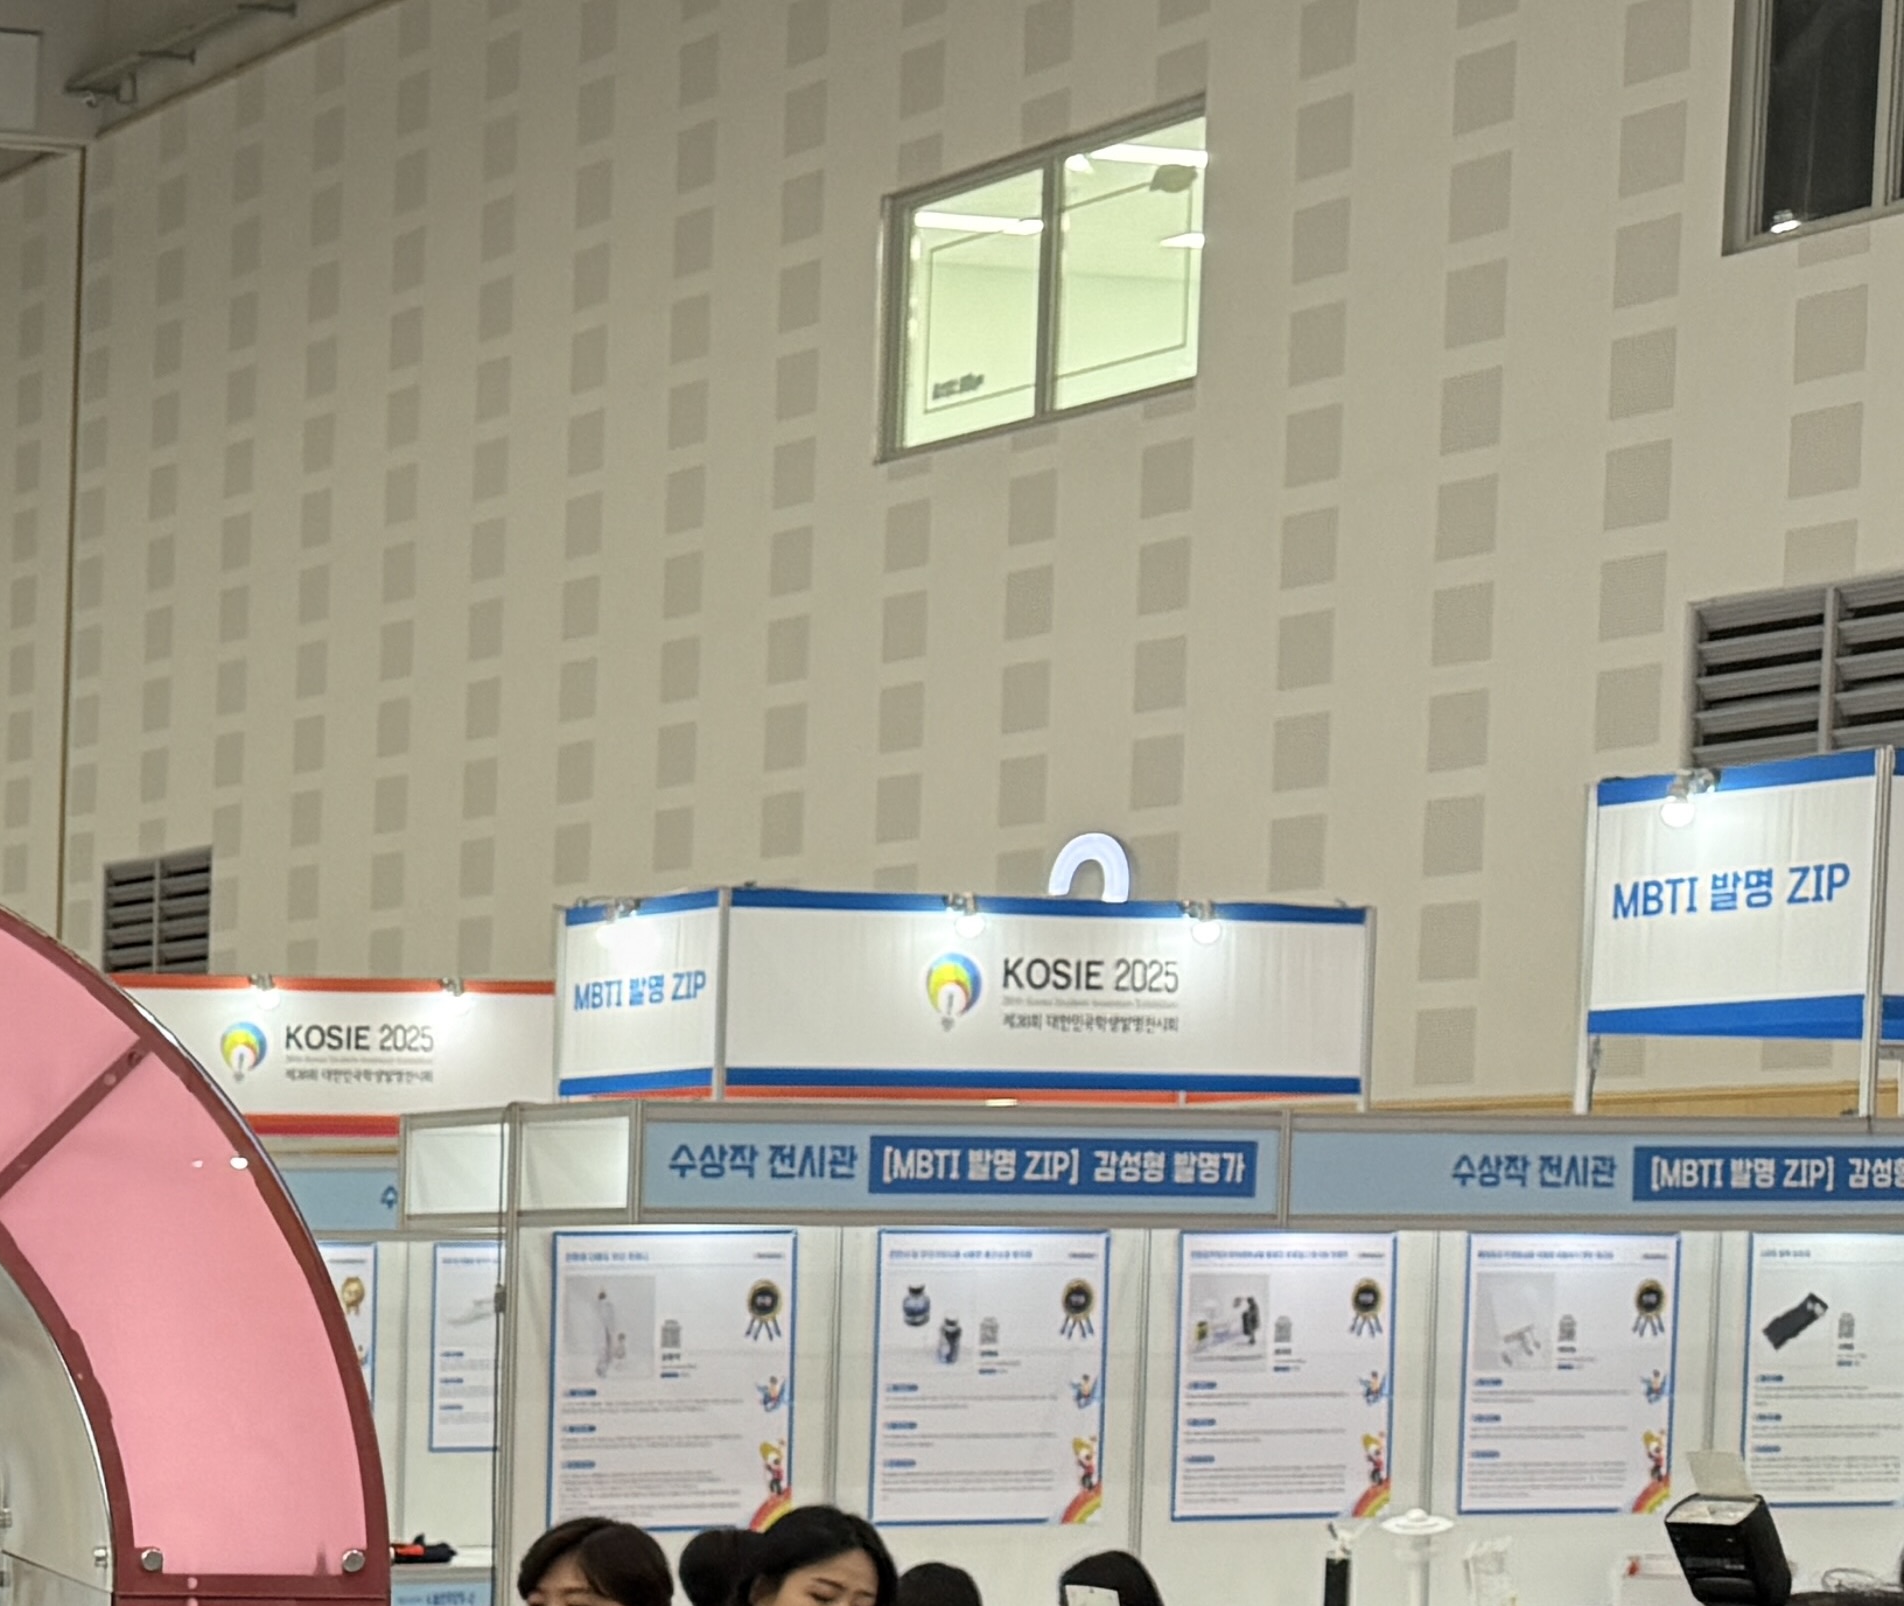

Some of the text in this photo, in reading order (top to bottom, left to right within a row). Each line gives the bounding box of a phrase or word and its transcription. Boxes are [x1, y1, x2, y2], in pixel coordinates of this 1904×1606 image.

[1612, 861, 1851, 921] MBTI 발명 ZIP
[574, 970, 707, 1012] MBTI 발명 ZIP
[1002, 957, 1179, 994] KOSIE 2025
[285, 1023, 434, 1053] KOSIE 2025
[667, 1143, 760, 1179] 수상작
[768, 1143, 859, 1180] 전시관
[967, 1148, 1017, 1182] 발명
[1093, 1151, 1166, 1184] 감성형
[1173, 1152, 1247, 1184] 발명가
[1451, 1153, 1531, 1189] 수상작
[1538, 1154, 1616, 1189] 전시관
[1730, 1157, 1777, 1190] 발명
